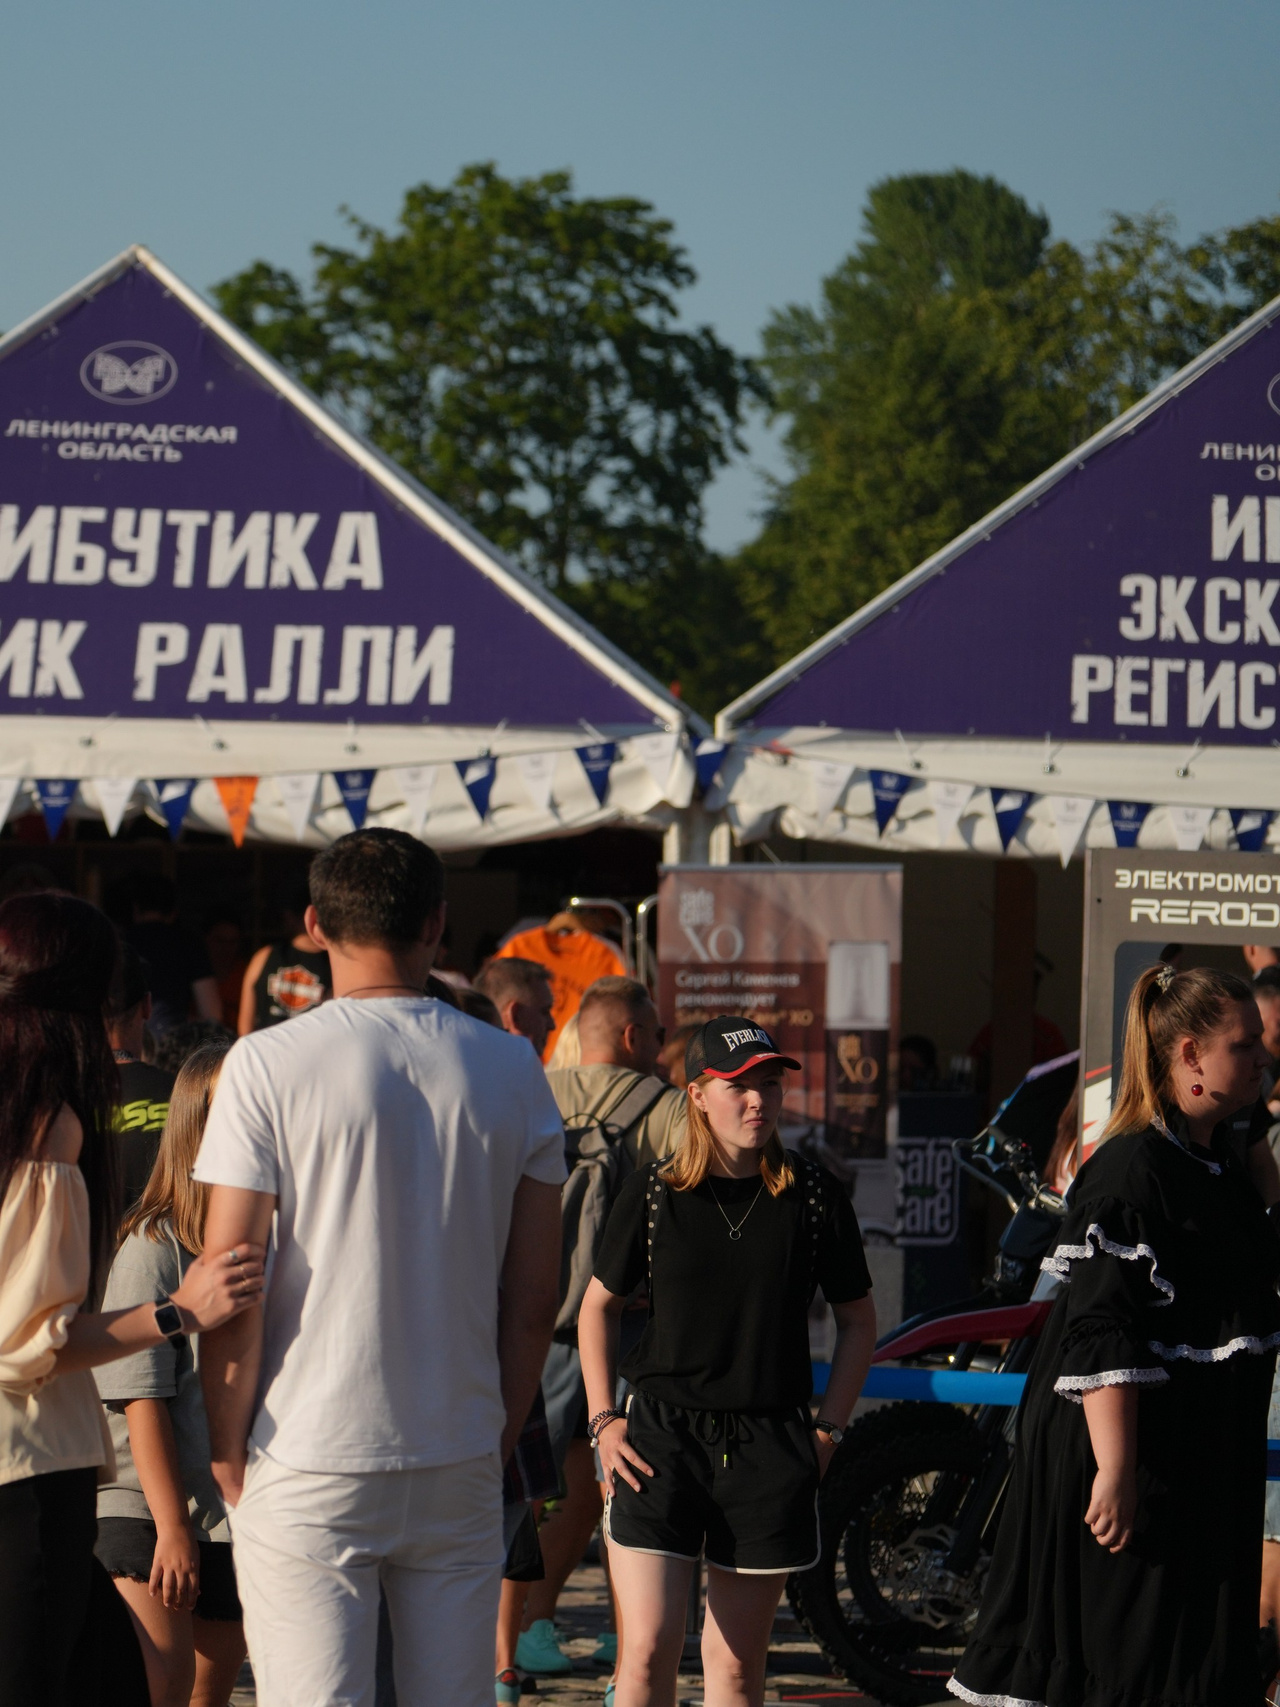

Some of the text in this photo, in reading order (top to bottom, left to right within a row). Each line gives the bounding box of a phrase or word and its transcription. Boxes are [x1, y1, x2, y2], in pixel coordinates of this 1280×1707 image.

[4, 419, 238, 444] ЛЕНИНГРАДСКАЯ
[58, 441, 183, 463] ОБЛАСТЬ
[1200, 442, 1280, 461] ЛЕНИ
[133, 622, 455, 706] РАЛЛИ
[1071, 653, 1280, 731] РЕГИС
